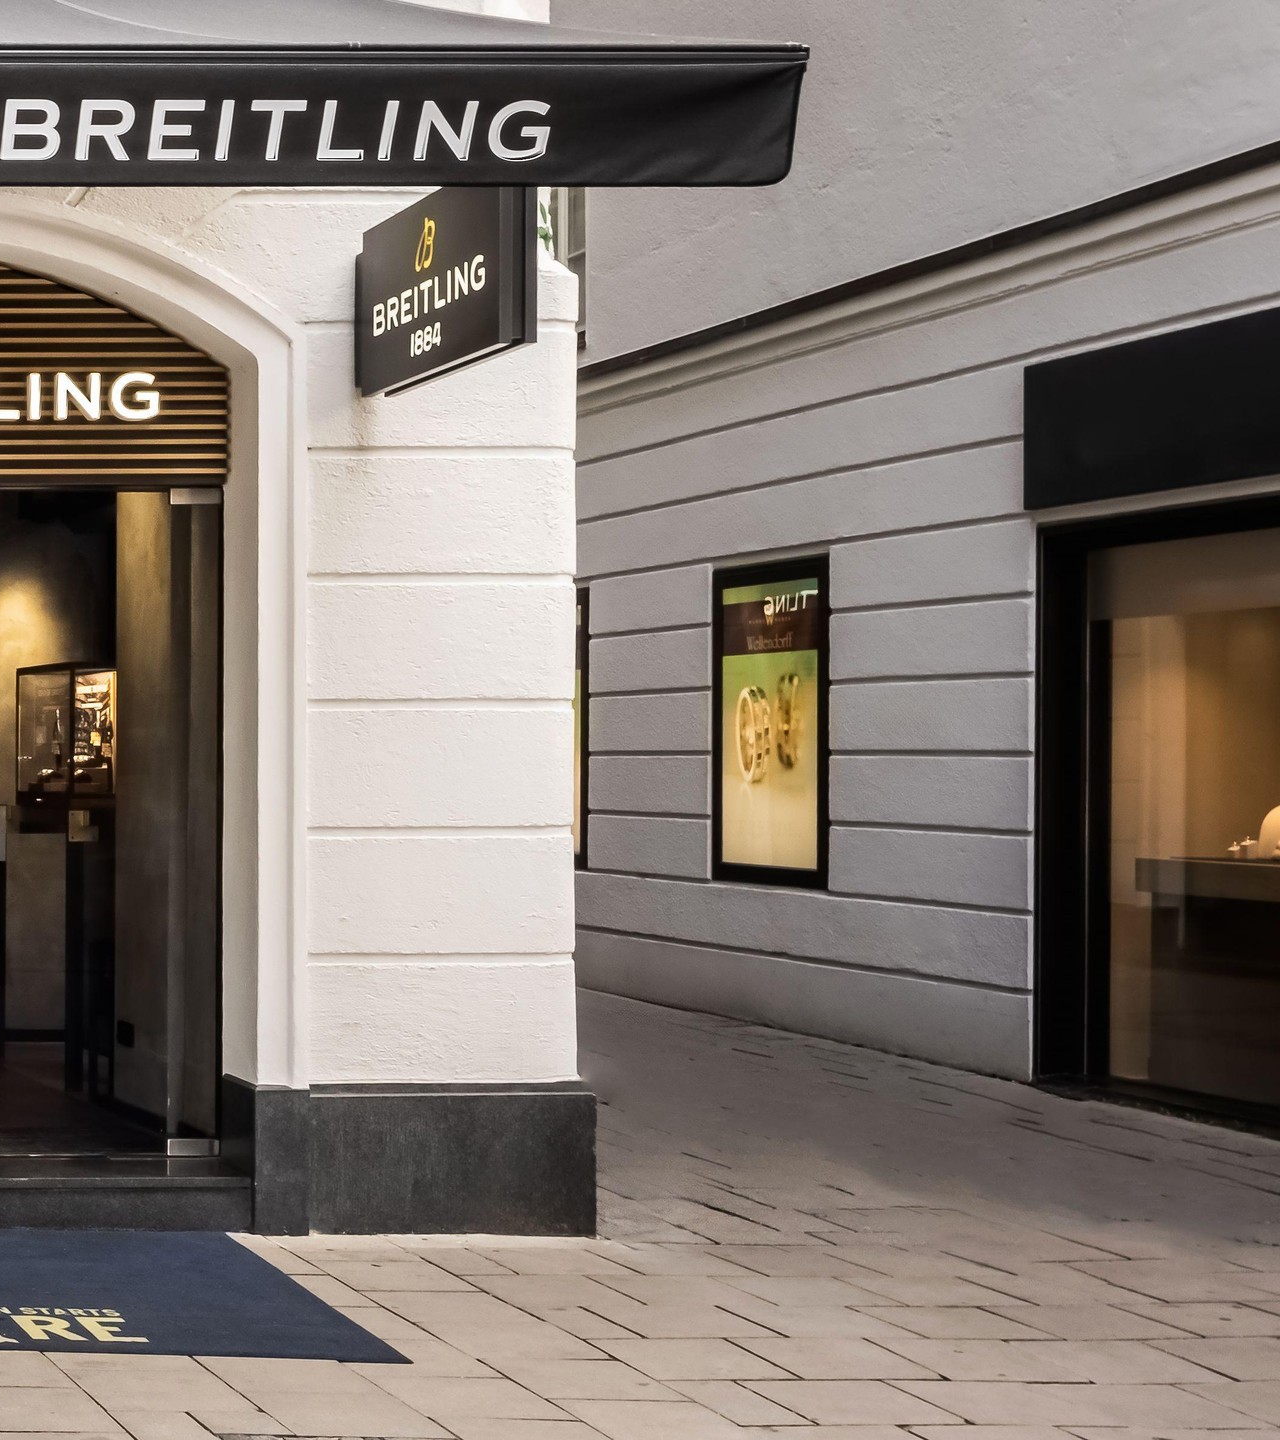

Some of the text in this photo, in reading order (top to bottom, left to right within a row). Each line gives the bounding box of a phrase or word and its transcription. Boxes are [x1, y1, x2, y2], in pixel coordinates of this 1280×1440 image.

[0, 99, 552, 162] BREITLING
[372, 254, 486, 337] BREITLING
[410, 322, 442, 358] 1884
[19, 1307, 121, 1317] STARTS
